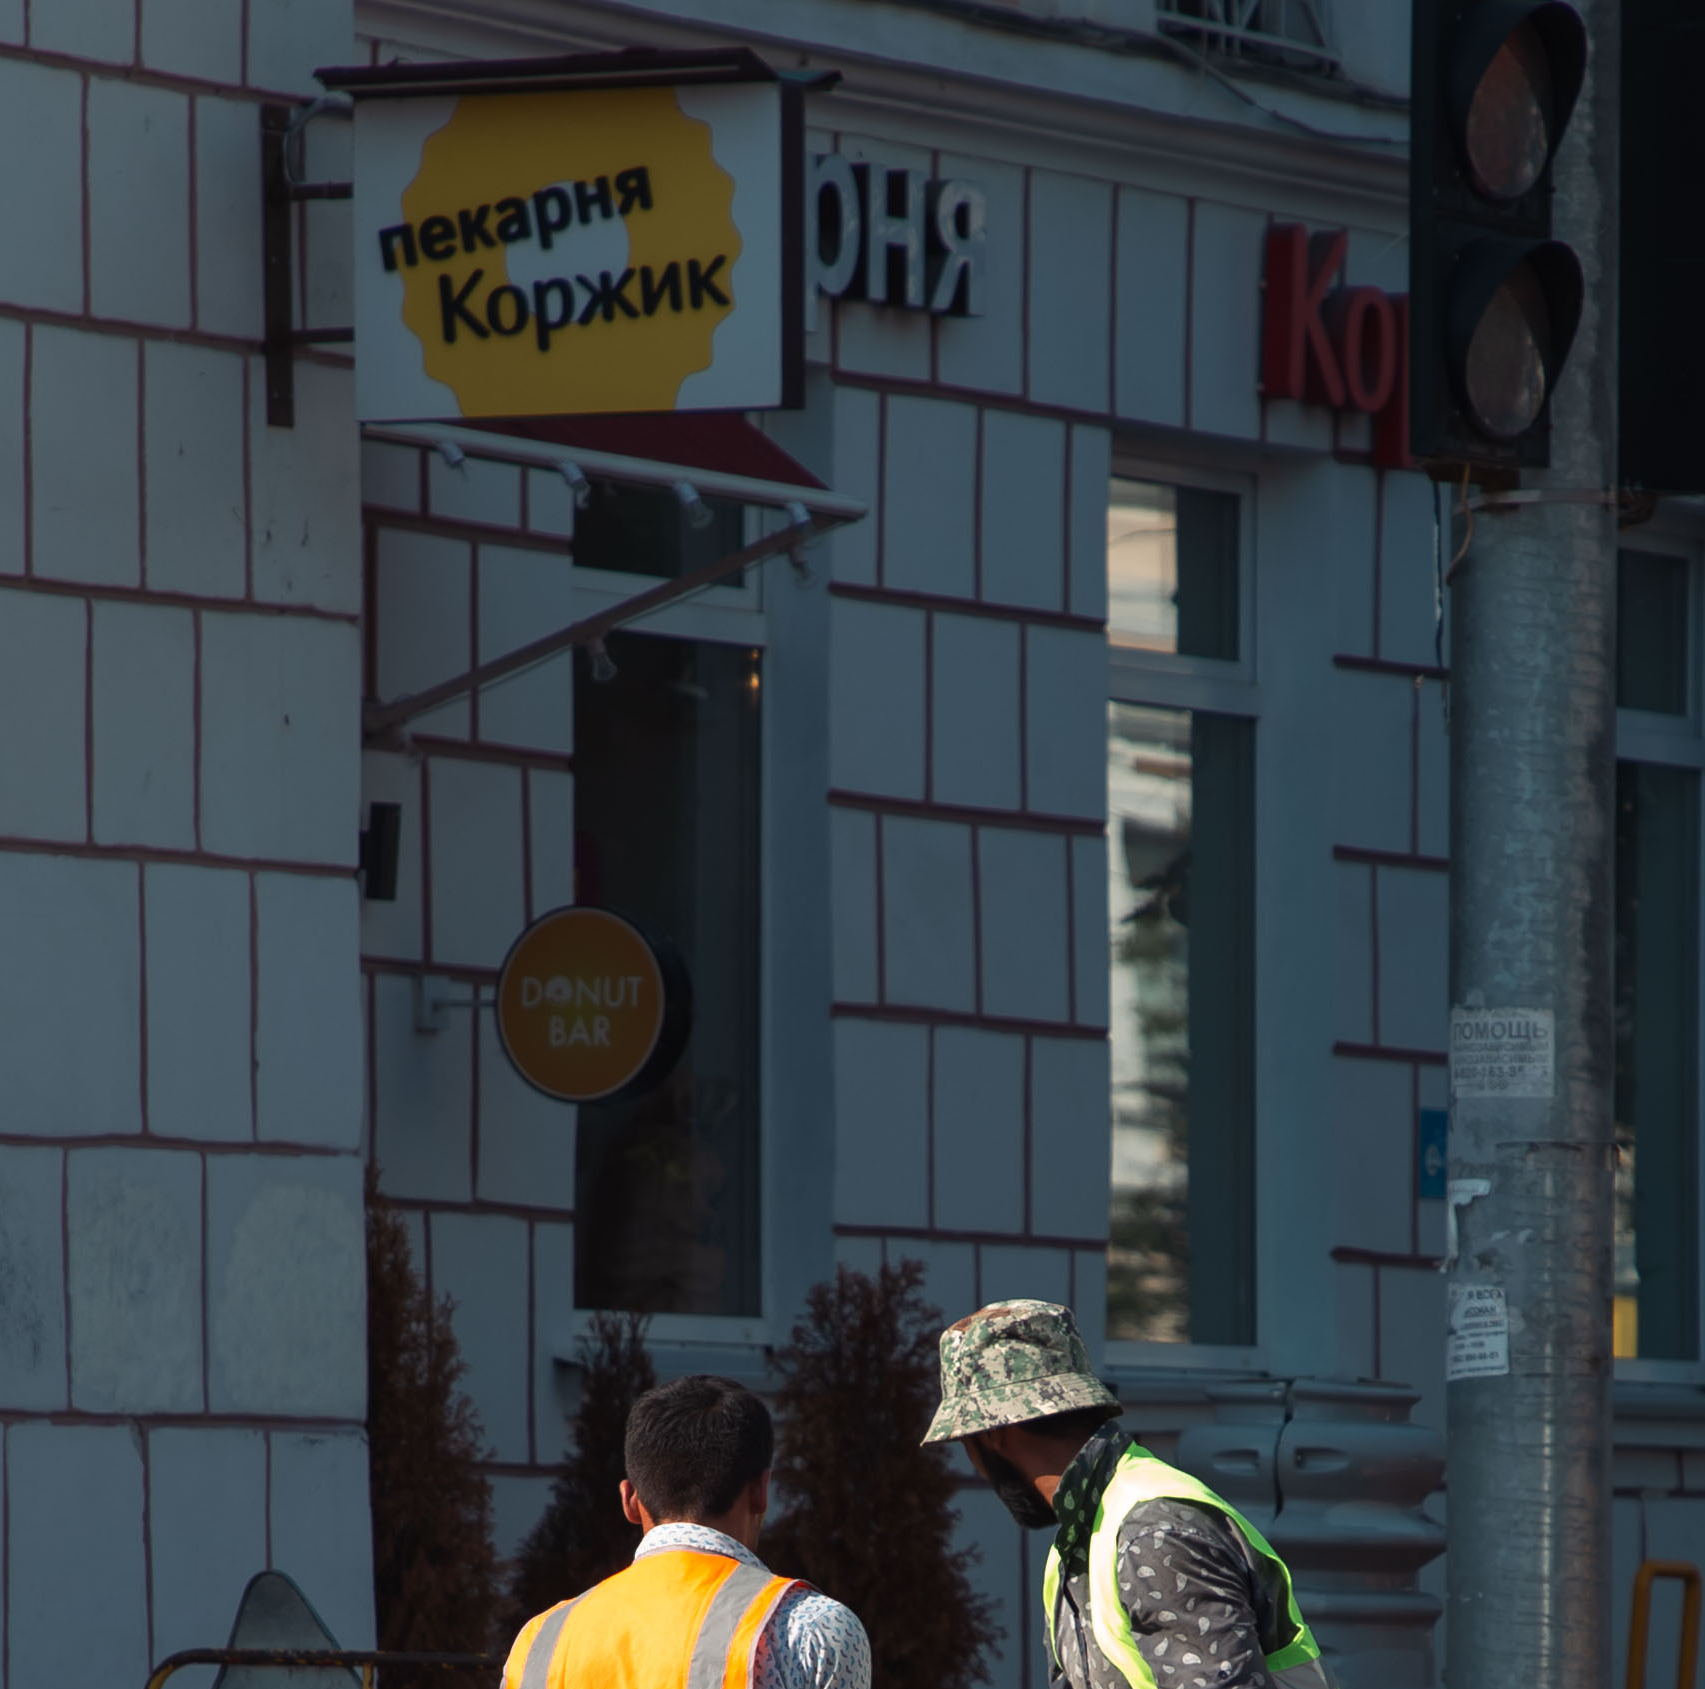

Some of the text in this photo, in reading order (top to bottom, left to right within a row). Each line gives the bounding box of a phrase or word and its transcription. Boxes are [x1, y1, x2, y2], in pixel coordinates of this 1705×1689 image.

[378, 165, 654, 273] пекарня
[806, 153, 988, 333] рня
[437, 253, 732, 352] Коржик
[521, 974, 644, 1009] DONUT
[549, 1015, 612, 1048] BAR
[1454, 1020, 1549, 1042] ПОМОЩЬ
